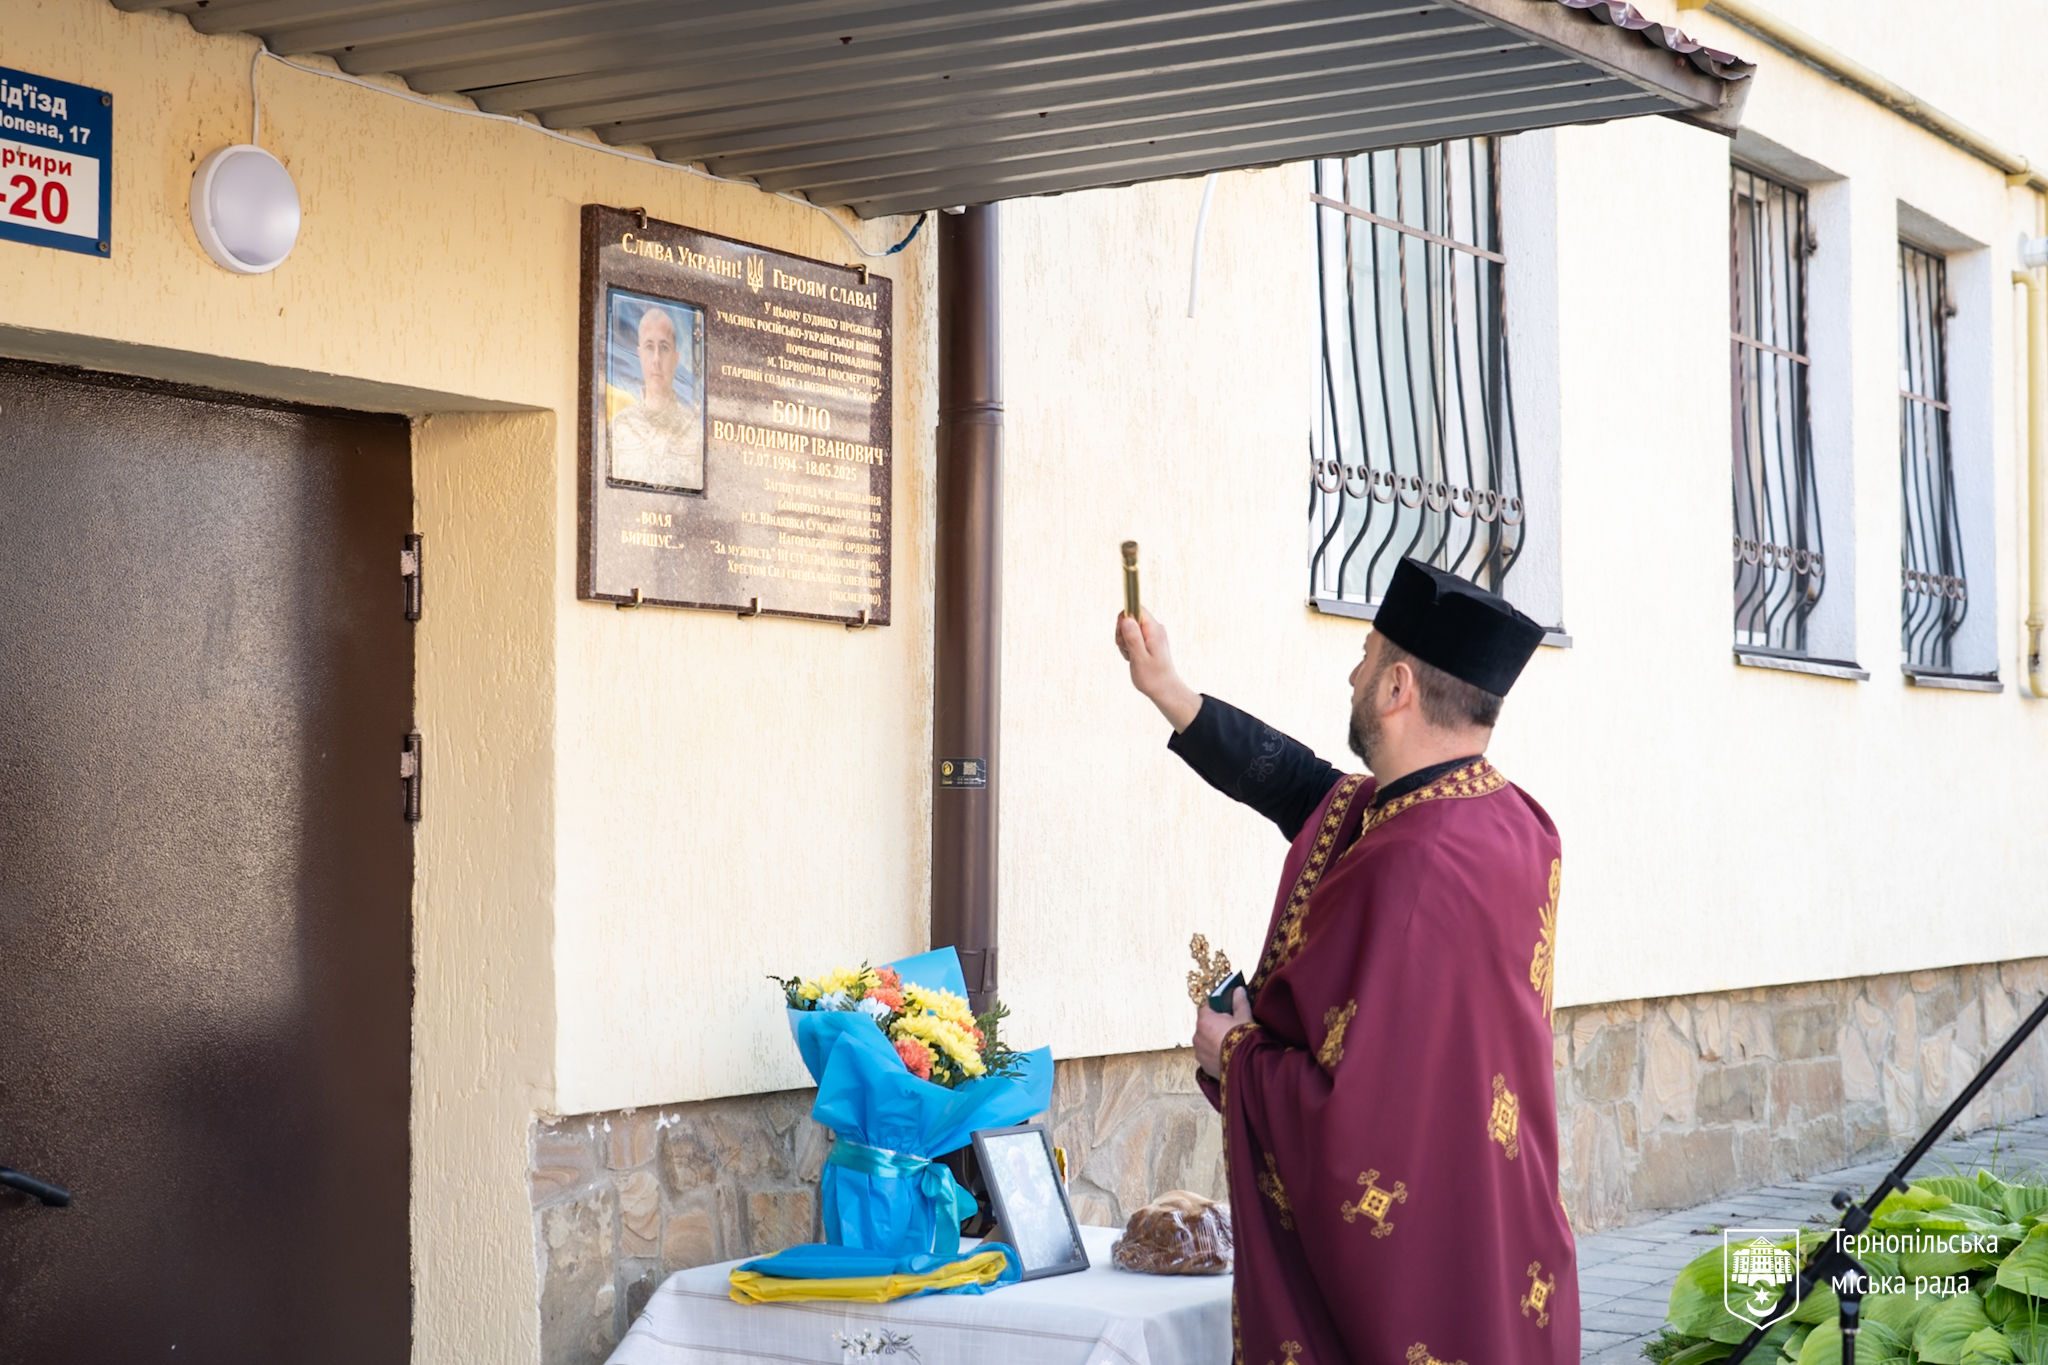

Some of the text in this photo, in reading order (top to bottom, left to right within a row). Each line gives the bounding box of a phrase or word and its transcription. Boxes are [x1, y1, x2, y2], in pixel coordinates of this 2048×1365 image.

[0, 79, 67, 120] ід’їзд
[69, 126, 91, 144] 17
[0, 148, 72, 177] ртири
[0, 174, 68, 224] -20
[622, 233, 877, 310] СЛАВА УКРАЇНІ! ГЕРОЯМ СЛАВА!
[717, 310, 756, 329] УЧАСНИК
[757, 319, 854, 349] РОСІЙСЬКО-УКРАЇНСЬКОЇ
[764, 302, 882, 339] У ЦЬОМУ БУДИНКУ ПРОЖИВАВ
[779, 356, 826, 378] ТЕРНОПОЛЯ
[786, 343, 882, 371] ПОЧЕСНИЙ ГРОМАДЯНИН
[721, 365, 762, 382] СТАРШИЙ
[764, 374, 796, 388] СОЛДАТ
[804, 380, 847, 398] ПОЗИВНИМ
[772, 399, 831, 432] БОЇЛО
[713, 420, 883, 466] ВОЛОДИМИР ІВАНОВИЧ
[743, 451, 796, 472] 17.07.1994
[805, 460, 856, 481] 18.05.2025
[835, 491, 881, 507] ВИКОНАННЯ
[761, 512, 805, 530] ЮНАКІВКА
[806, 518, 846, 535] СУМСЬКОЇ
[821, 507, 861, 521] ЗАВДАННЯ
[779, 532, 881, 556] НАГОРОДЖЕНИЙ ОРДЕНОМ
[790, 553, 826, 566] СТУПЕНЯ
[727, 560, 766, 577] ХРЕСТОМ
[844, 576, 881, 589] ОПЕРАЦІЙ
